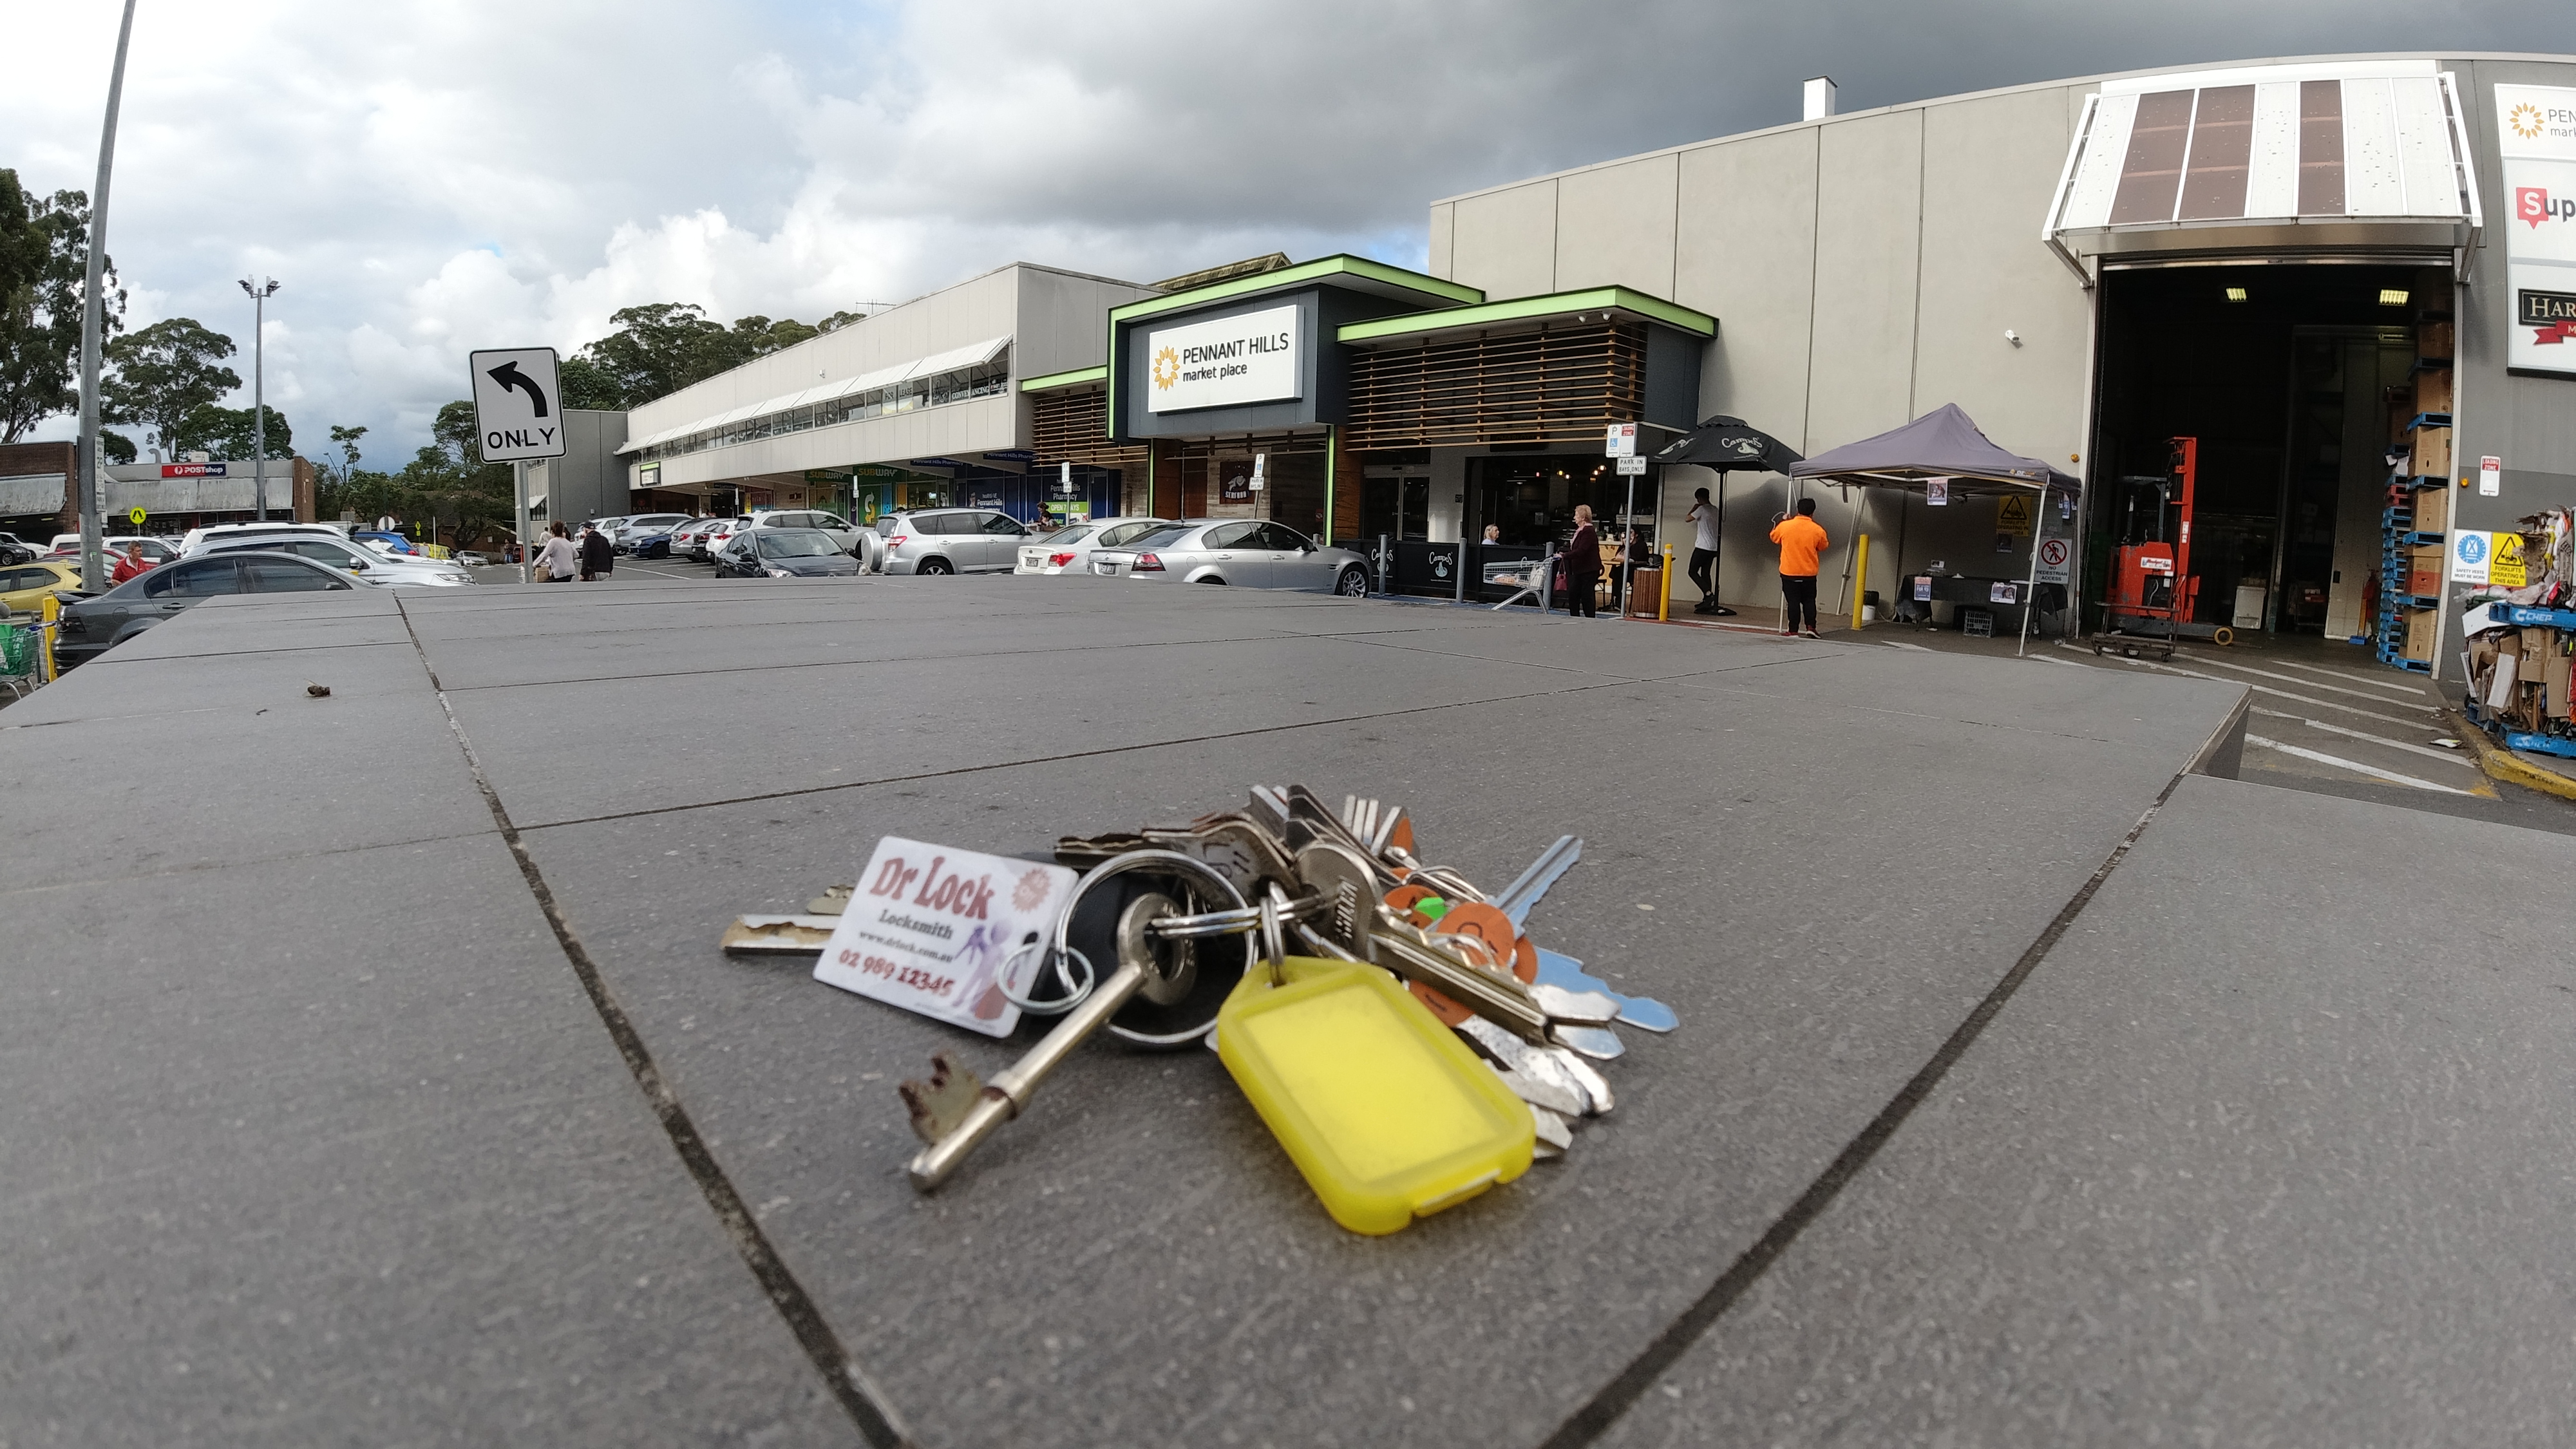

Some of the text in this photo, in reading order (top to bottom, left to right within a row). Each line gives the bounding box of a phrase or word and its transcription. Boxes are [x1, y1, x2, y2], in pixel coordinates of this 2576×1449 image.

[2524, 191, 2576, 223] Sup
[2530, 297, 2576, 318] HAR
[1183, 332, 1289, 365] PENNANT HILLS
[1182, 363, 1247, 382] market place
[900, 387, 913, 397] LEASE
[488, 427, 556, 449] ONLY
[1612, 426, 1618, 435] P
[809, 471, 844, 479] SUBWAY
[858, 468, 896, 477] SUBWAY
[2526, 612, 2553, 621] CHEP
[870, 856, 995, 920] Dr Lock
[878, 909, 954, 940] Locksmith
[859, 931, 954, 963] www.drlock.com.au
[838, 949, 956, 997] 02 989 12345
